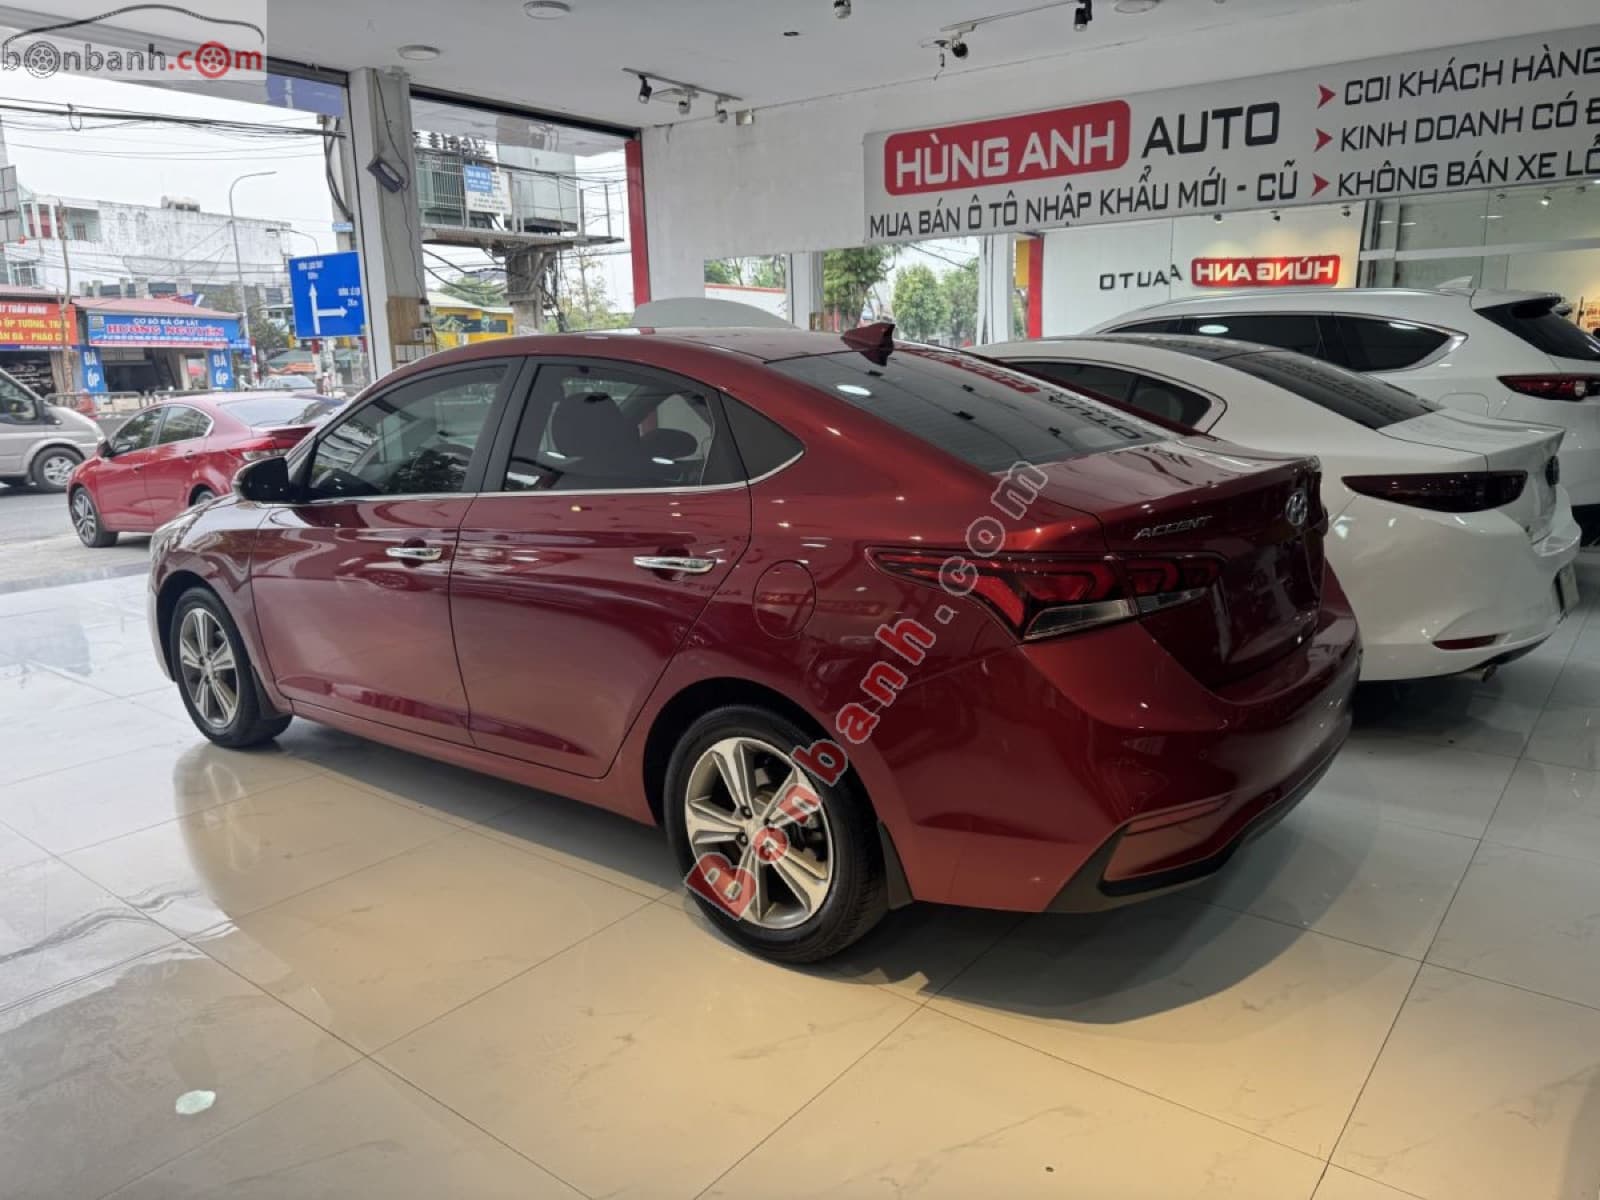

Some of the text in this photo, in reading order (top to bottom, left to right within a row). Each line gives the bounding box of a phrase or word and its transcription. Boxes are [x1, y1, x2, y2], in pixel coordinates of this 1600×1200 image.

[1344, 76, 1391, 105] COI
[1398, 57, 1503, 99] KHÁCH
[896, 102, 1280, 188] HÙNG ANH AUTO
[1341, 119, 1407, 151] KINH
[1415, 107, 1523, 143] DOANH
[1532, 91, 1578, 130] CÓ
[870, 211, 912, 238] MUA
[918, 197, 960, 234] BÁN
[968, 194, 982, 229] Ô
[989, 189, 1017, 227] TÔ
[1026, 182, 1092, 227] NHẬP
[1100, 165, 1168, 216] KHẨU
[1178, 166, 1226, 208] MỚI
[1257, 159, 1298, 201] CŨ
[1338, 160, 1438, 196] KHÔNG
[1447, 150, 1509, 186] BÁN
[1515, 152, 1557, 181] XE
[1134, 515, 1213, 540] ACCENT
